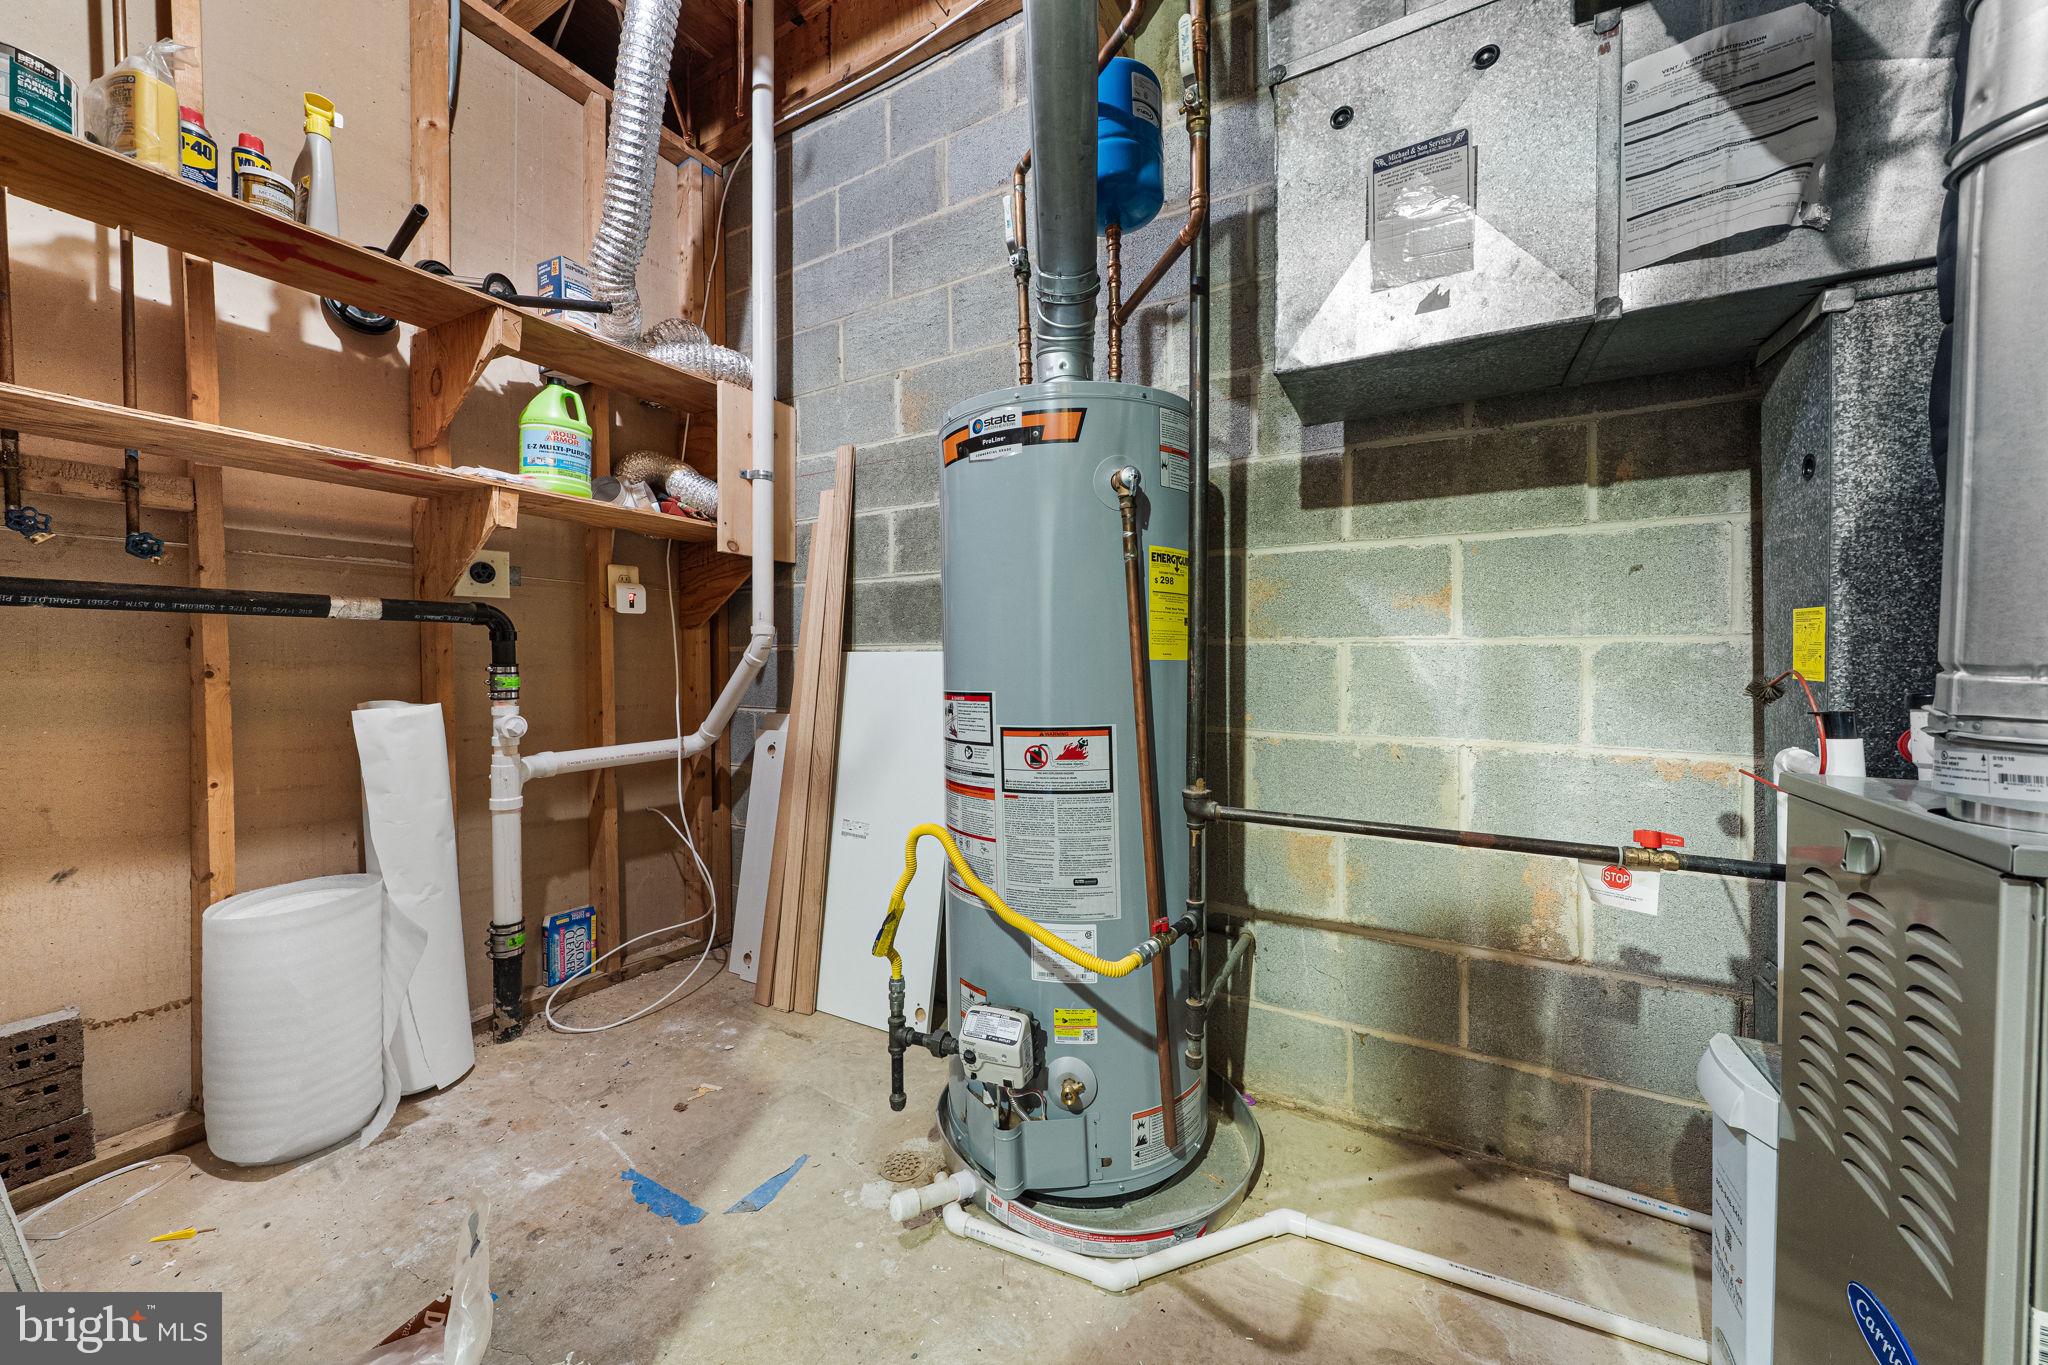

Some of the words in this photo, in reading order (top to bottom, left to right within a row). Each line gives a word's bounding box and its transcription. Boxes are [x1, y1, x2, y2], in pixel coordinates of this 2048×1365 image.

[17, 52, 45, 69] BEHR
[1661, 64, 1679, 75] VENT
[1685, 49, 1716, 65] CHIMNEY
[1716, 34, 1768, 53] CERTIFICATION
[17, 73, 59, 97] CABINET
[17, 79, 58, 103] ENAMEL
[181, 136, 213, 160] -40
[1387, 149, 1410, 161] Michael
[1410, 146, 1417, 155] &
[1417, 144, 1428, 152] Son
[1428, 137, 1452, 148] Services
[983, 413, 1016, 427] state
[545, 433, 581, 447] ARMOR
[551, 430, 577, 440] MOLD
[982, 437, 1005, 446] ProLine
[1159, 576, 1175, 585] 298
[19, 595, 81, 605] CHARLOTTE
[125, 600, 150, 609] ASTM
[154, 601, 165, 609] 40
[1604, 871, 1630, 885] STOP
[564, 929, 576, 974] CLEANER
[574, 926, 587, 971] CUSTOM
